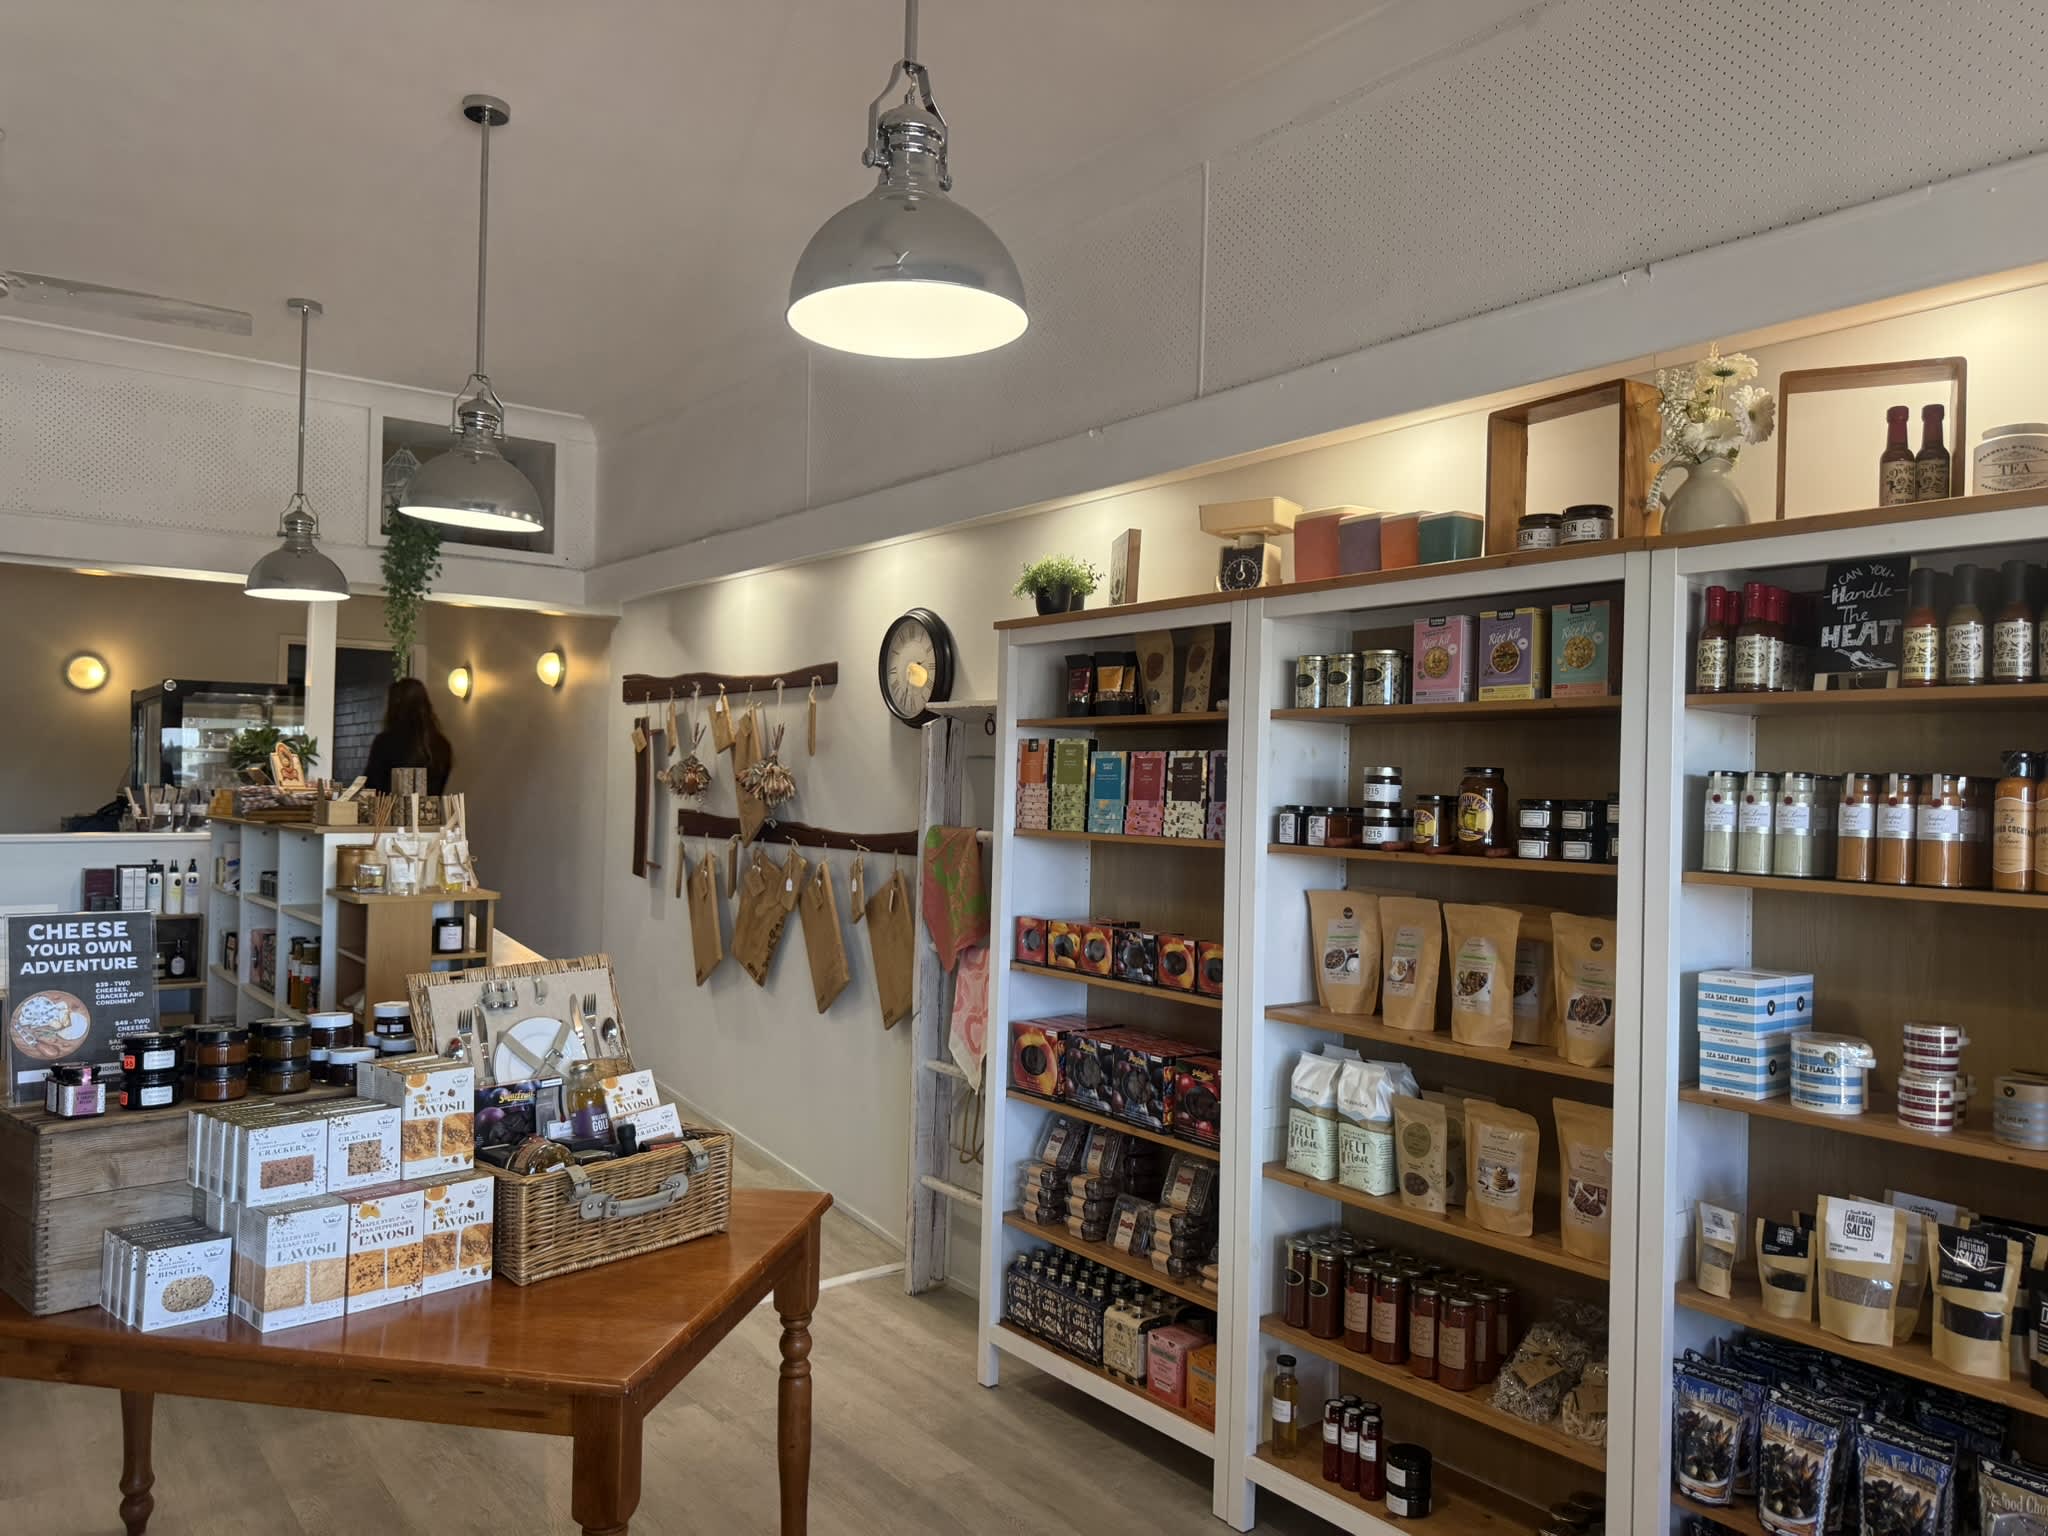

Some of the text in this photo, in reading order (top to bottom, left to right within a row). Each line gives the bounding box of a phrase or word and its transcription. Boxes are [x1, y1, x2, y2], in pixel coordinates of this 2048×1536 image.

[1998, 463, 2031, 477] TEA
[1838, 567, 1864, 585] CAN
[1832, 582, 1894, 605] Handle
[1837, 604, 1869, 624] The
[1488, 628, 1521, 646] Rice Kit
[1562, 627, 1580, 640] Rice
[1821, 619, 1902, 648] HEAT
[28, 921, 128, 941] CHEESE
[26, 940, 132, 957] YOUR OWN
[20, 957, 138, 975] ADVENTURE
[96, 998, 136, 1006] CONDIMENT
[1729, 996, 1749, 1004] FLAKES
[1731, 1054, 1751, 1064] FLAKES
[1810, 1065, 1834, 1075] FLAKES
[414, 1101, 465, 1117] LAVOSH
[614, 1097, 654, 1114] LAVOSH
[338, 1132, 383, 1144] CRACKERS
[1290, 1122, 1319, 1140] SPELT
[258, 1145, 307, 1157] CRACKERS
[1296, 1137, 1318, 1149] FLOUR
[1346, 1151, 1369, 1165] FLOUR
[433, 1211, 485, 1230] LAVOSH
[1847, 1214, 1872, 1227] ARTISAN
[359, 1226, 415, 1247] LAVOSH
[1846, 1222, 1871, 1238] SALTS
[277, 1242, 337, 1262] LAVOSH
[1959, 1240, 1986, 1254] ARTISAN
[1957, 1249, 1984, 1267] SALTS
[158, 1267, 202, 1278] BISCUITS
